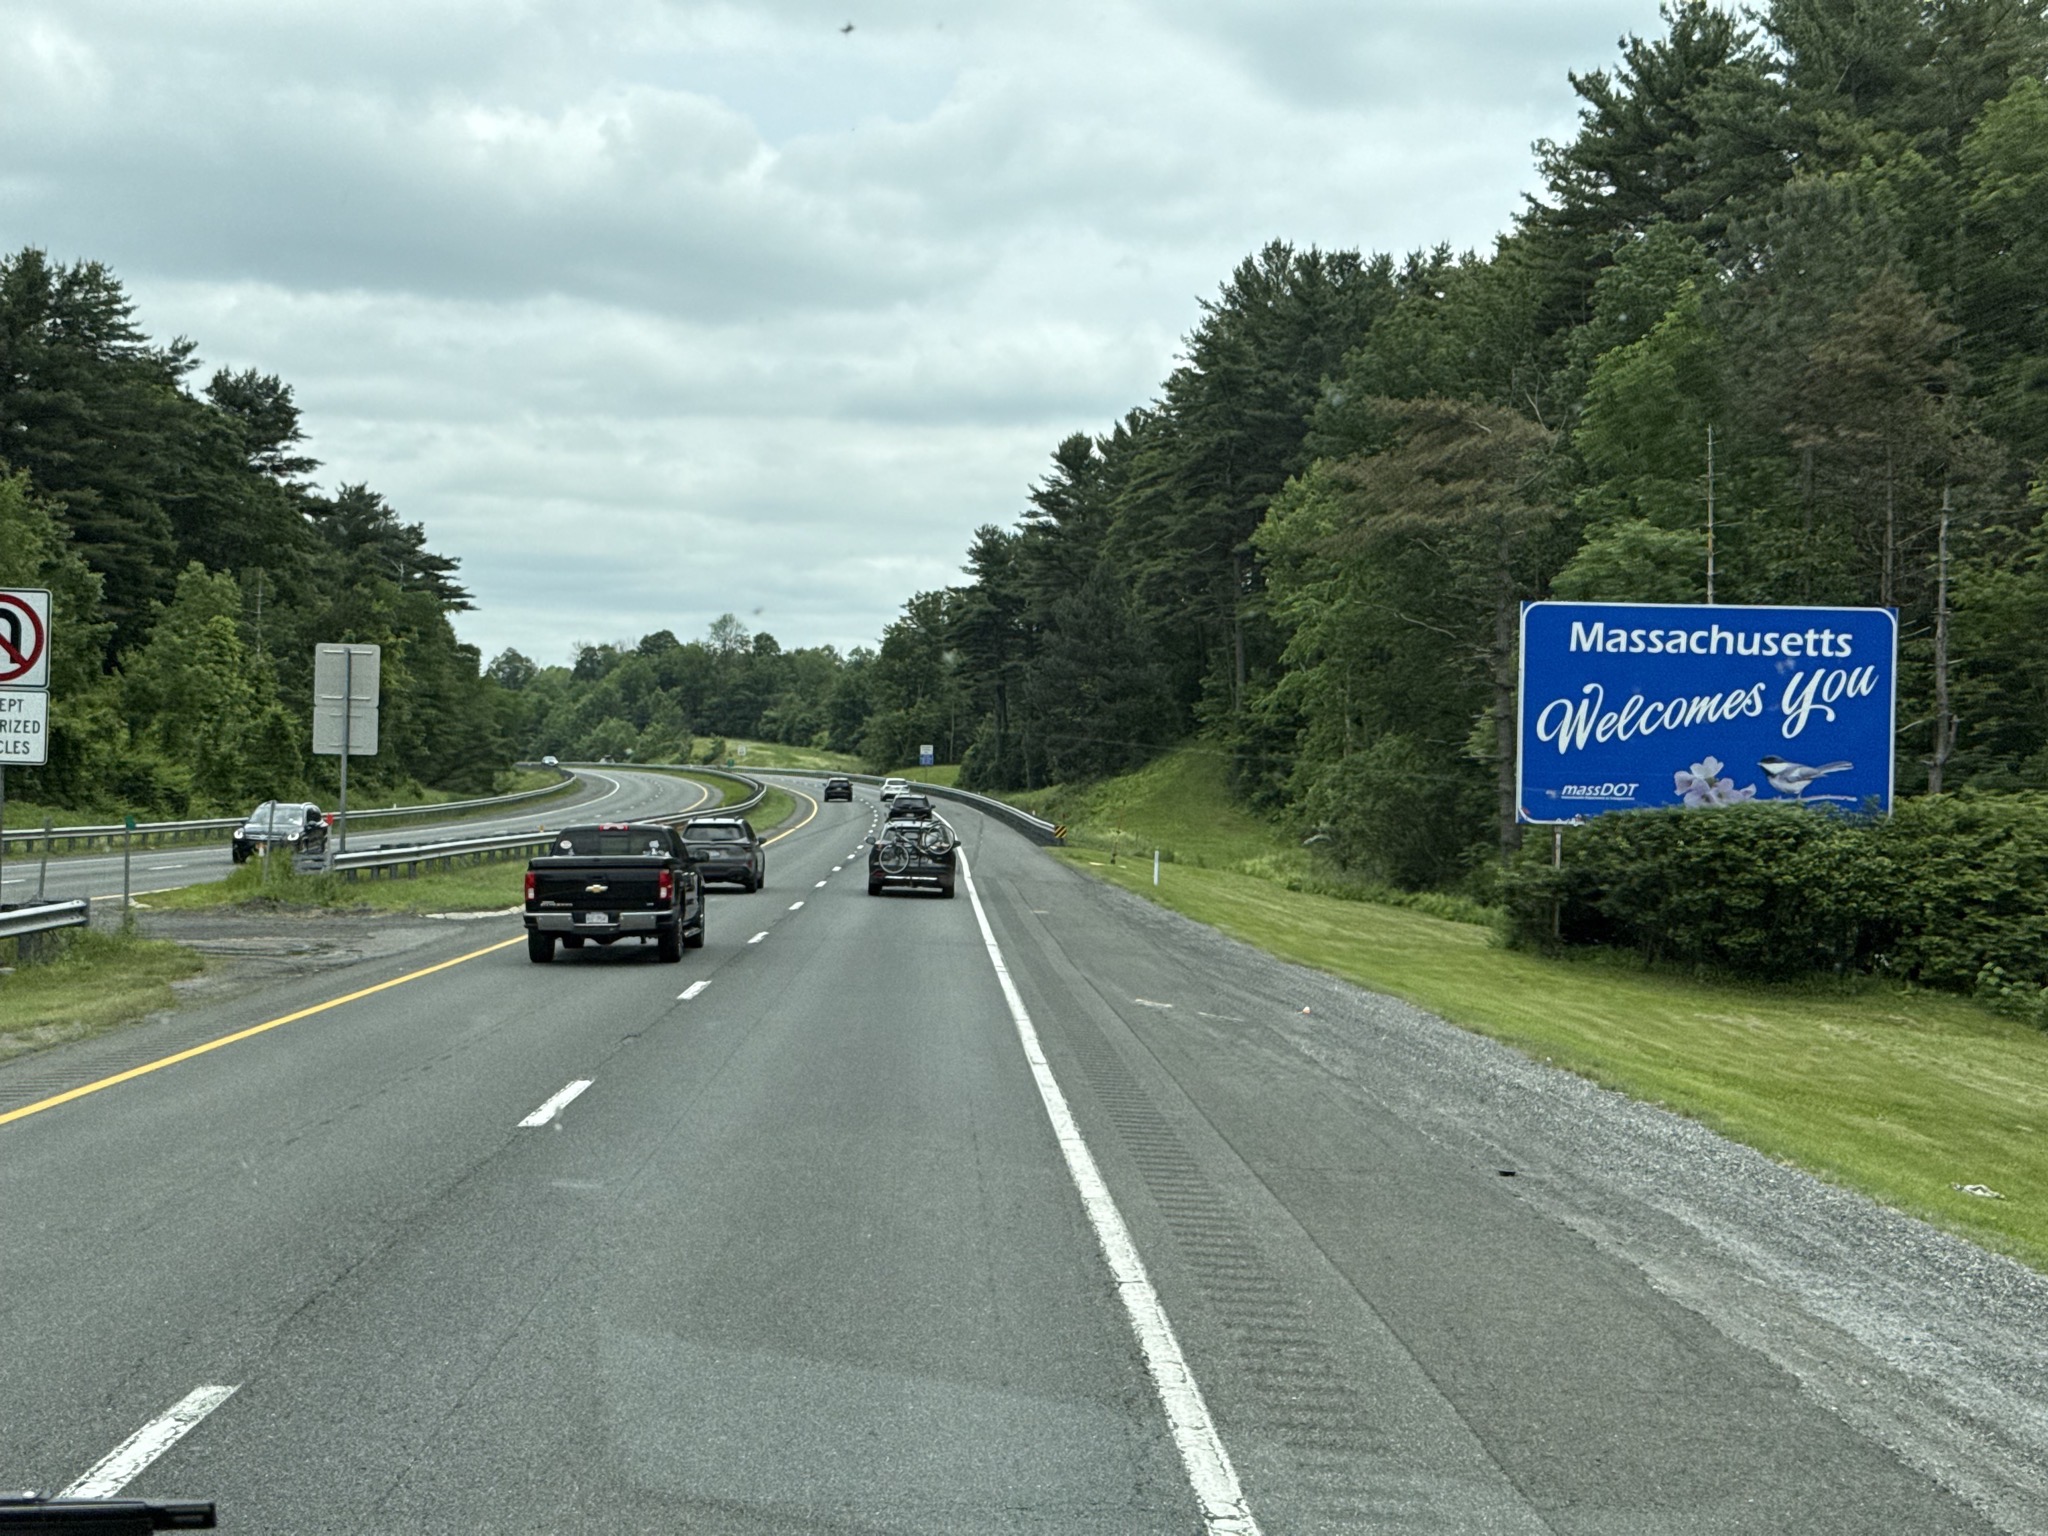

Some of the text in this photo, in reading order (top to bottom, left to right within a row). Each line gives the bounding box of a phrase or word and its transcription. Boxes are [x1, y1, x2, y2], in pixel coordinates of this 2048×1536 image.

[1569, 621, 1853, 657] Massachusetts
[0, 698, 24, 713] EPT
[1536, 665, 1879, 755] Welcomes You
[0, 719, 41, 734] RIZED
[1561, 783, 1639, 796] massDOT
